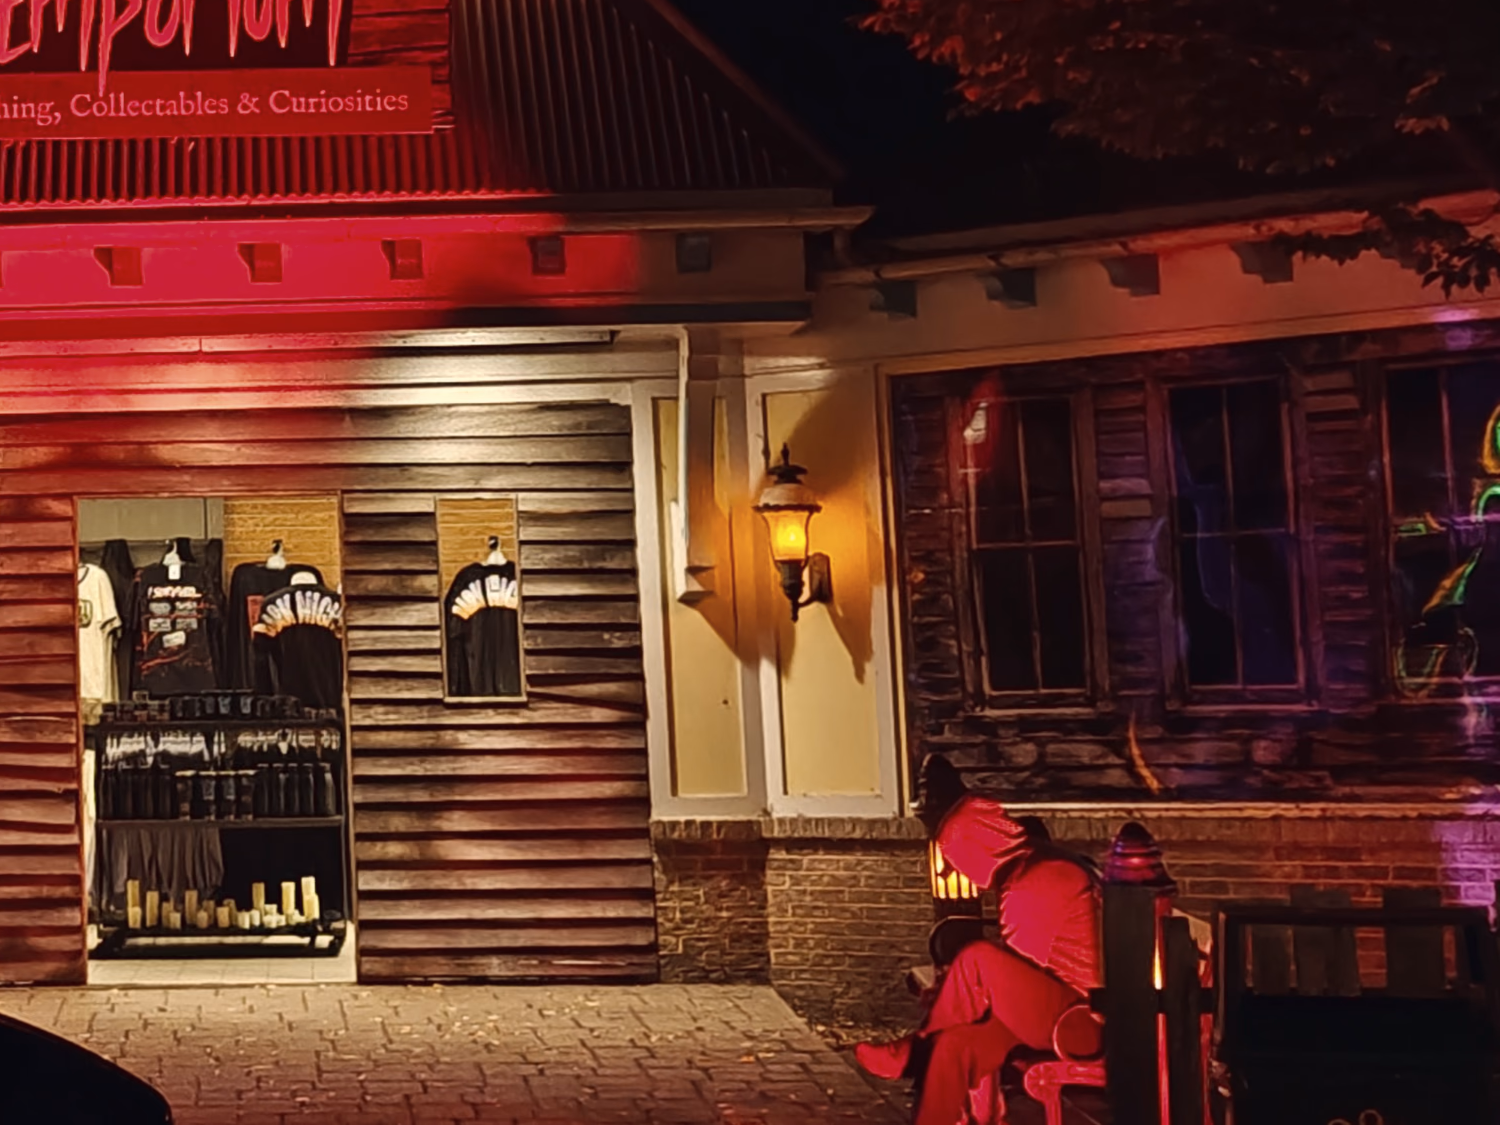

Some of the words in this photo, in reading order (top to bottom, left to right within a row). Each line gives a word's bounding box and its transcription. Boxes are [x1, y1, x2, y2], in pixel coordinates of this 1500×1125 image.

[69, 90, 230, 118] Collectables
[236, 92, 261, 115] &
[268, 88, 409, 115] Curiosities
